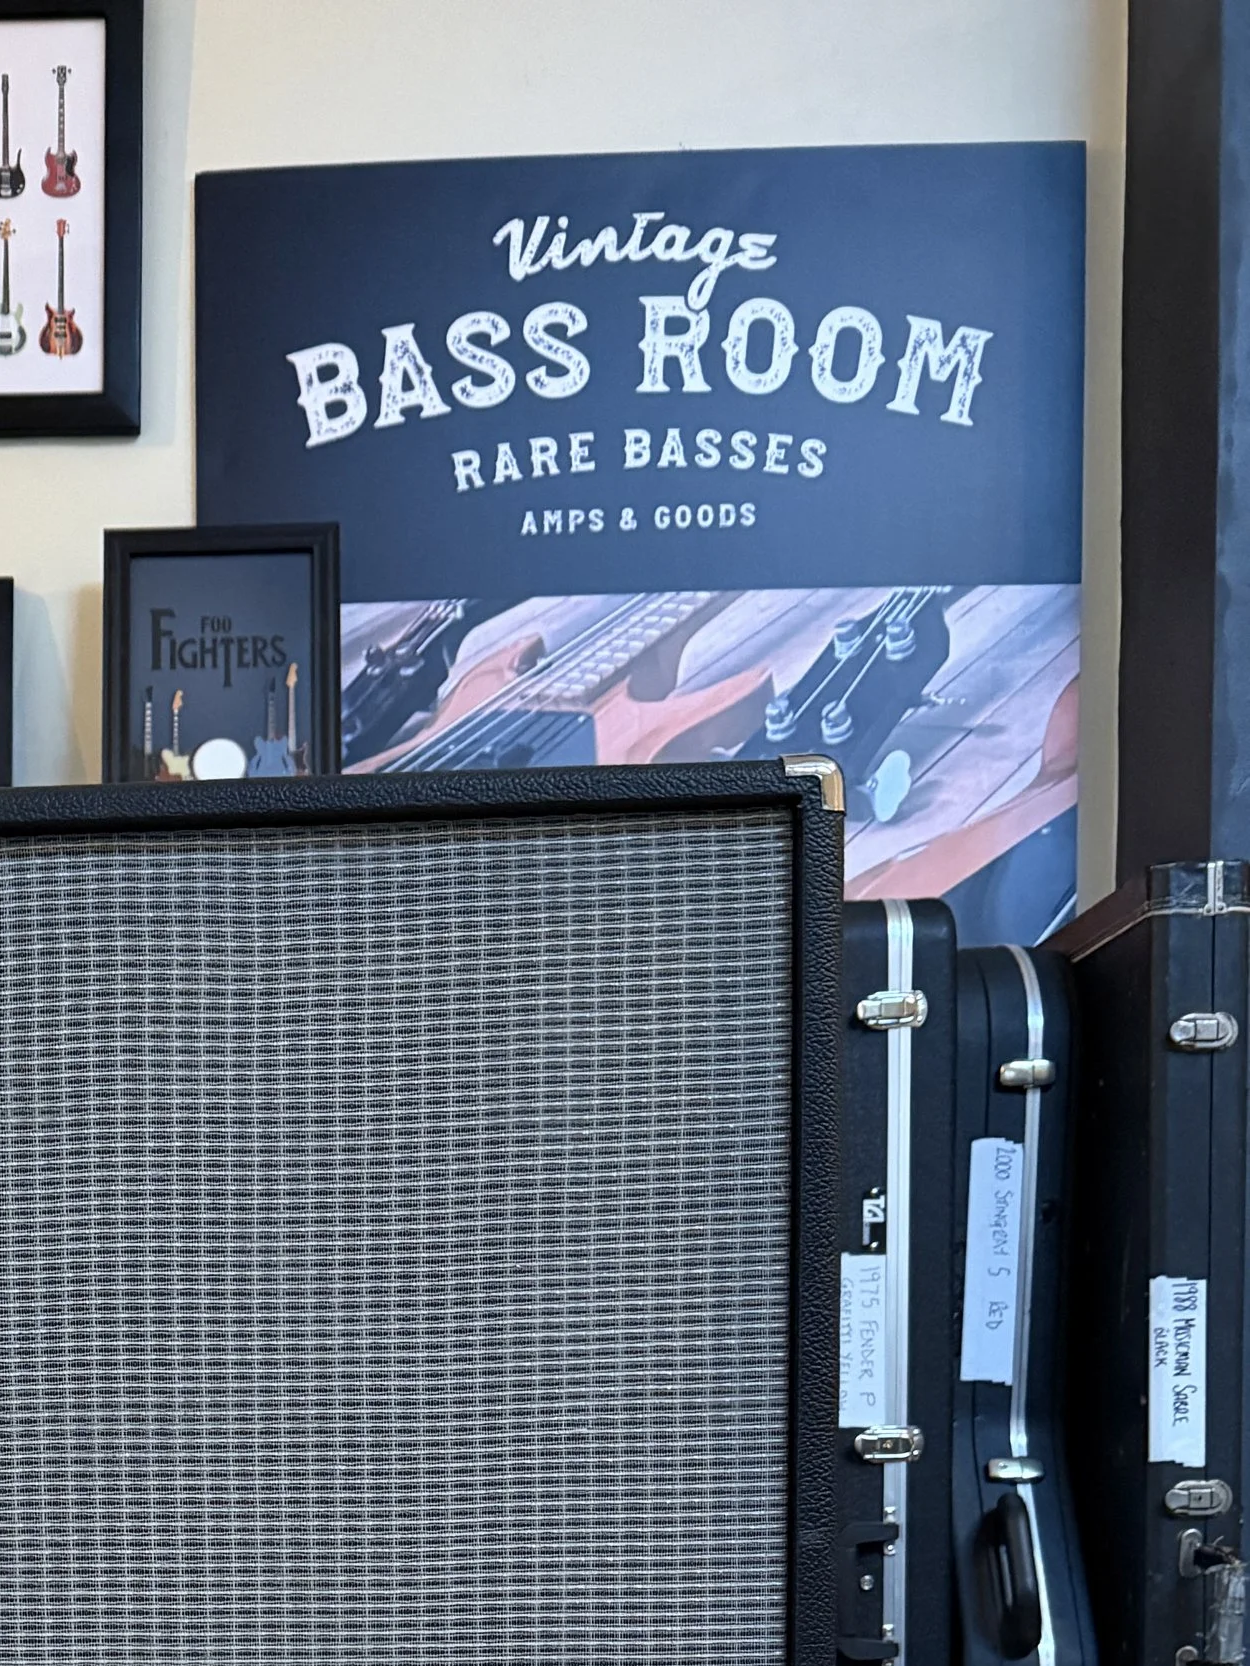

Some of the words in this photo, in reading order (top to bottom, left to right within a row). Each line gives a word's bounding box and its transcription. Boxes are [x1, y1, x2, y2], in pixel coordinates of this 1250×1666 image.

[493, 212, 777, 310] Vintage
[286, 301, 592, 449] BASS
[636, 296, 994, 426] ROOM
[451, 432, 596, 492] RARE
[624, 427, 828, 479] BASSES
[520, 508, 606, 536] AMPS
[618, 508, 639, 533] &
[653, 502, 757, 531] GOODS
[201, 615, 233, 634] FOO
[150, 607, 288, 689] FIGHTERS
[995, 1146, 1017, 1181] 2000
[860, 1265, 881, 1309] 1975
[987, 1266, 1011, 1278] 5
[986, 1300, 1008, 1330] RED
[1172, 1282, 1199, 1312] 1988
[858, 1319, 880, 1380] FENDER
[860, 1391, 877, 1407] P
[1172, 1384, 1198, 1427] SABRE
